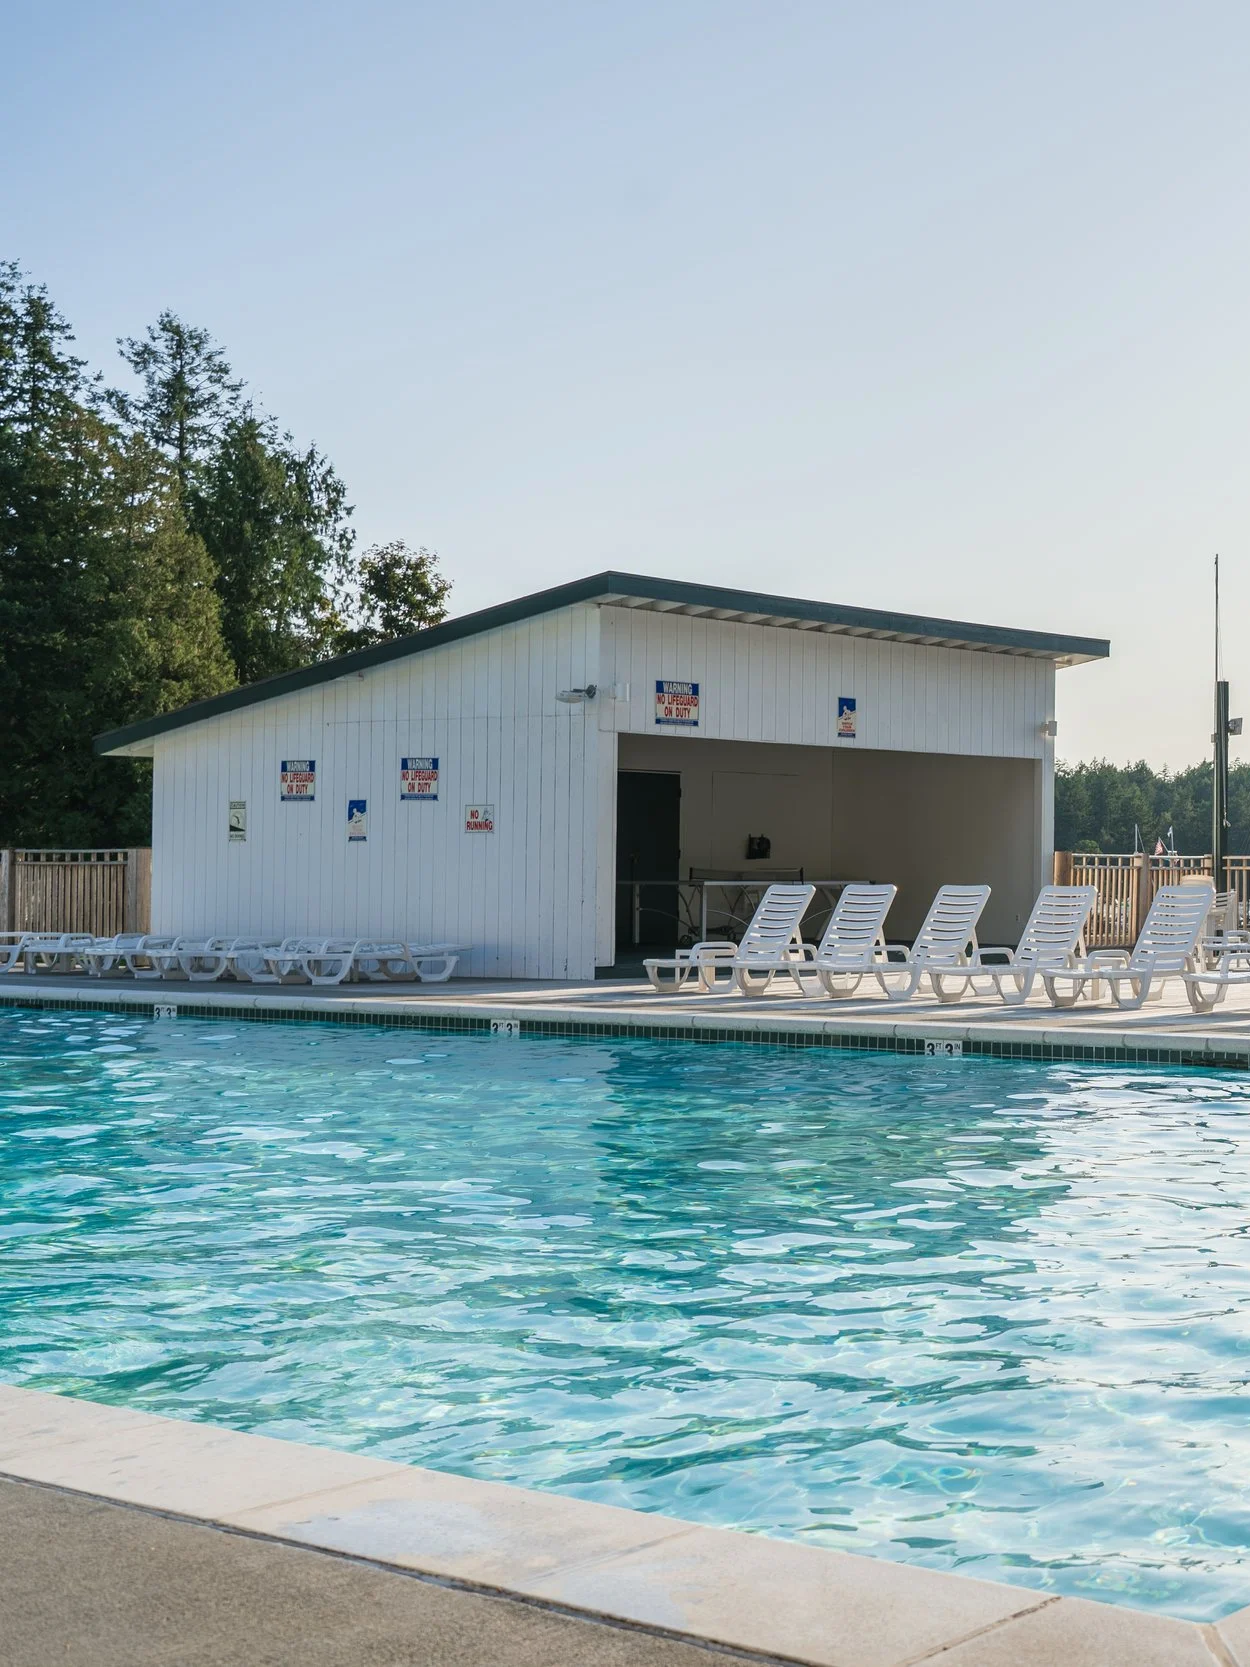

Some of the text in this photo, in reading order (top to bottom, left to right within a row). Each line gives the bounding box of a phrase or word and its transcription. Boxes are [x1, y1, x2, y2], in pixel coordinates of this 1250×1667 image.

[663, 682, 693, 695] WARNING
[657, 694, 698, 707] NO LIFEGUARD
[664, 706, 691, 718] ON DUTY
[407, 759, 433, 770] WARNING
[281, 772, 314, 783] NO LIFEGUARD
[402, 770, 438, 781] NO LIFEGUARD
[287, 783, 308, 794] ON DUTY
[408, 782, 431, 793] ON DUTY
[470, 810, 479, 820] NO
[466, 821, 493, 831] RUNNING
